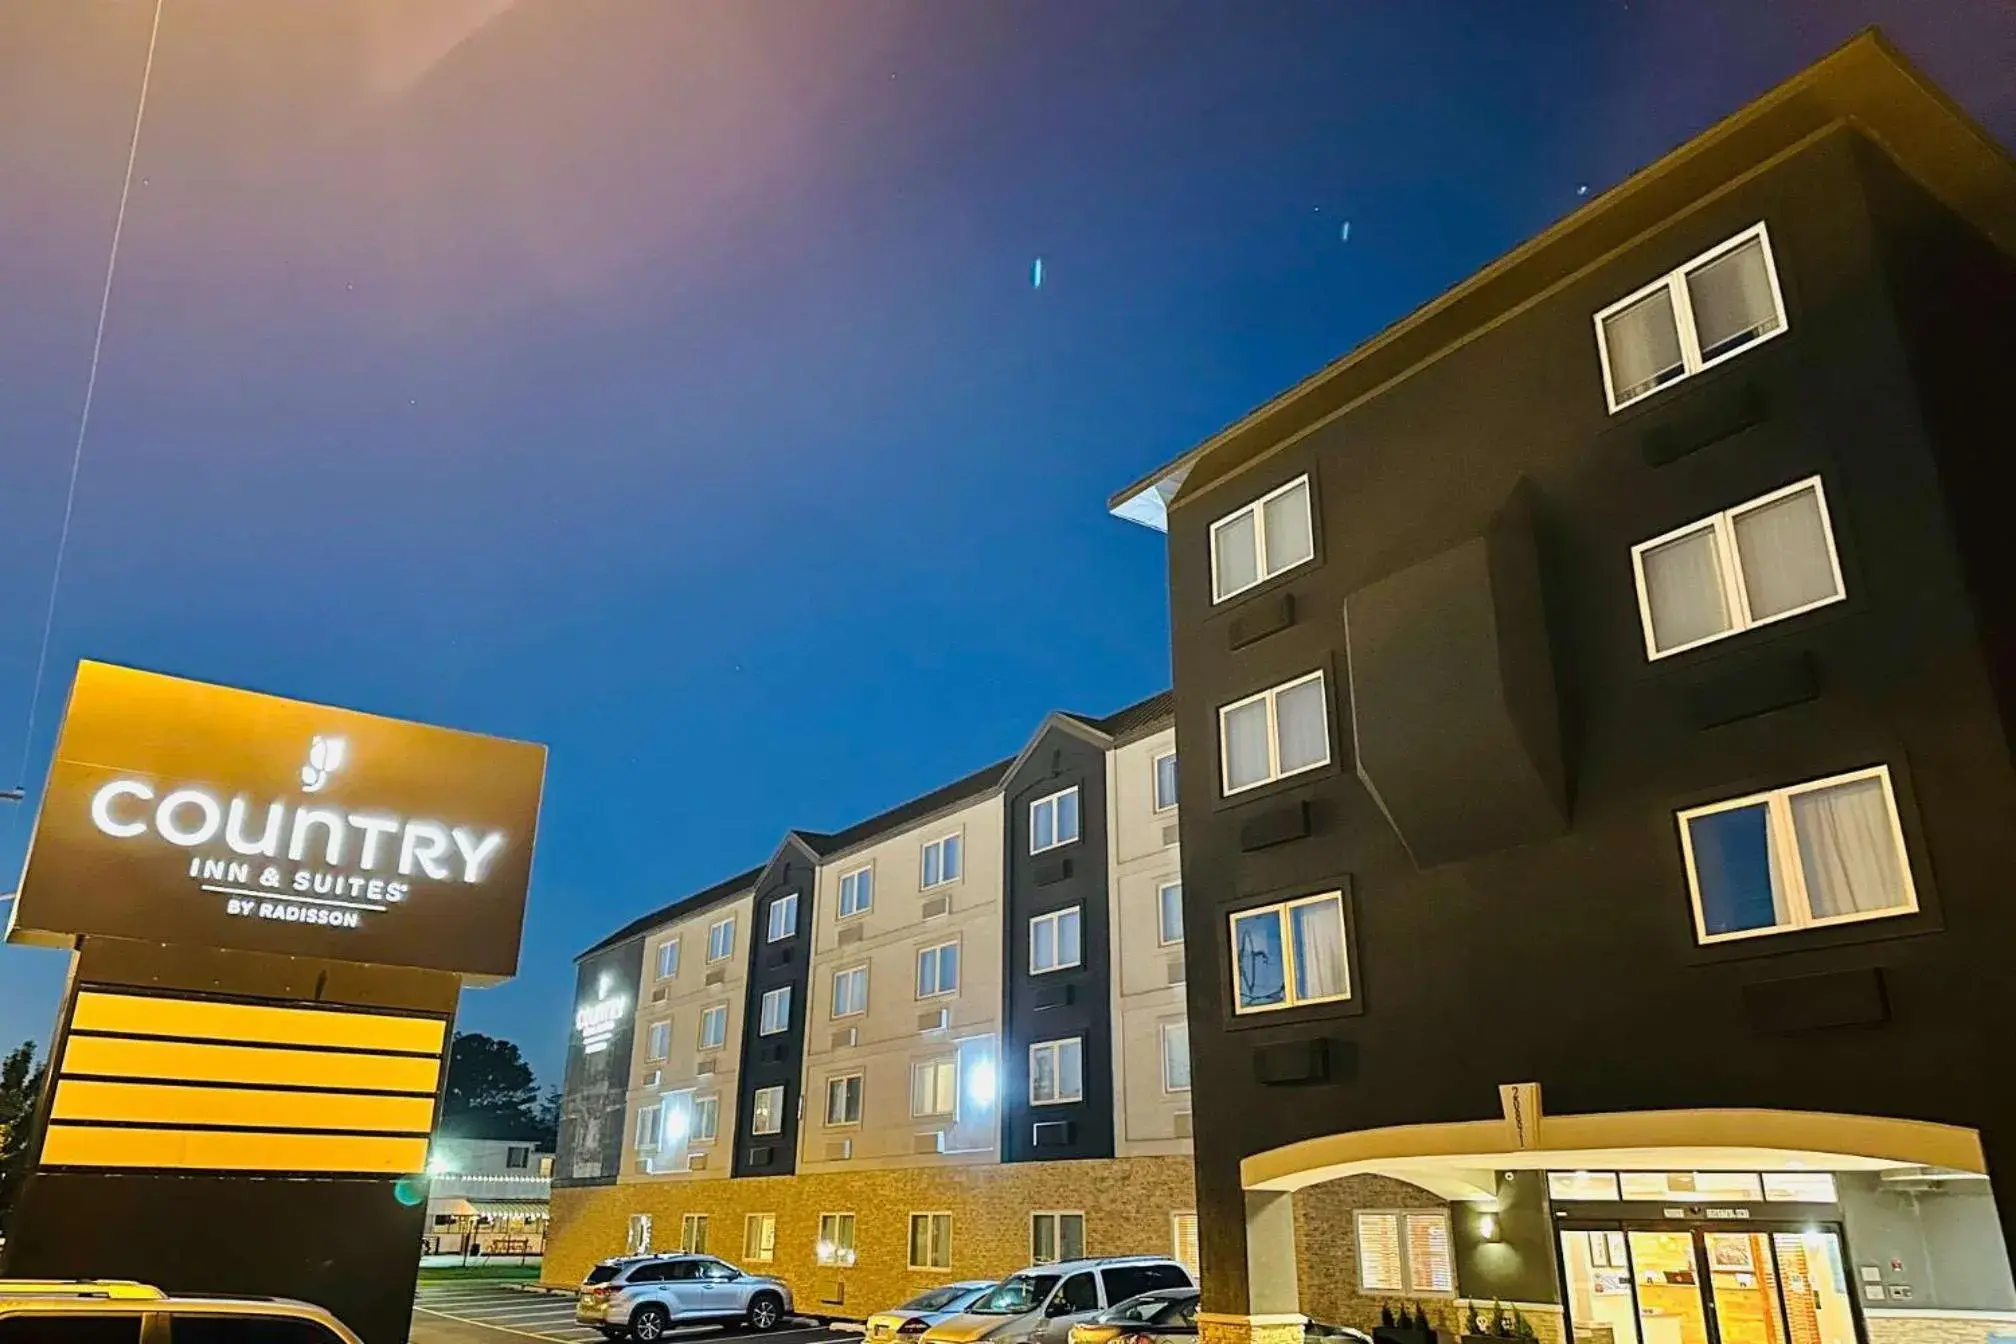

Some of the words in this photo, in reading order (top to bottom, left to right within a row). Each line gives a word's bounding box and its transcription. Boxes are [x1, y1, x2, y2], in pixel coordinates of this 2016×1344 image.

[91, 779, 503, 884] COUNTRY
[189, 857, 249, 883] INN
[259, 866, 281, 888] &
[293, 870, 405, 902] SUITES
[226, 899, 255, 916] BY
[258, 902, 359, 928] RADISSON
